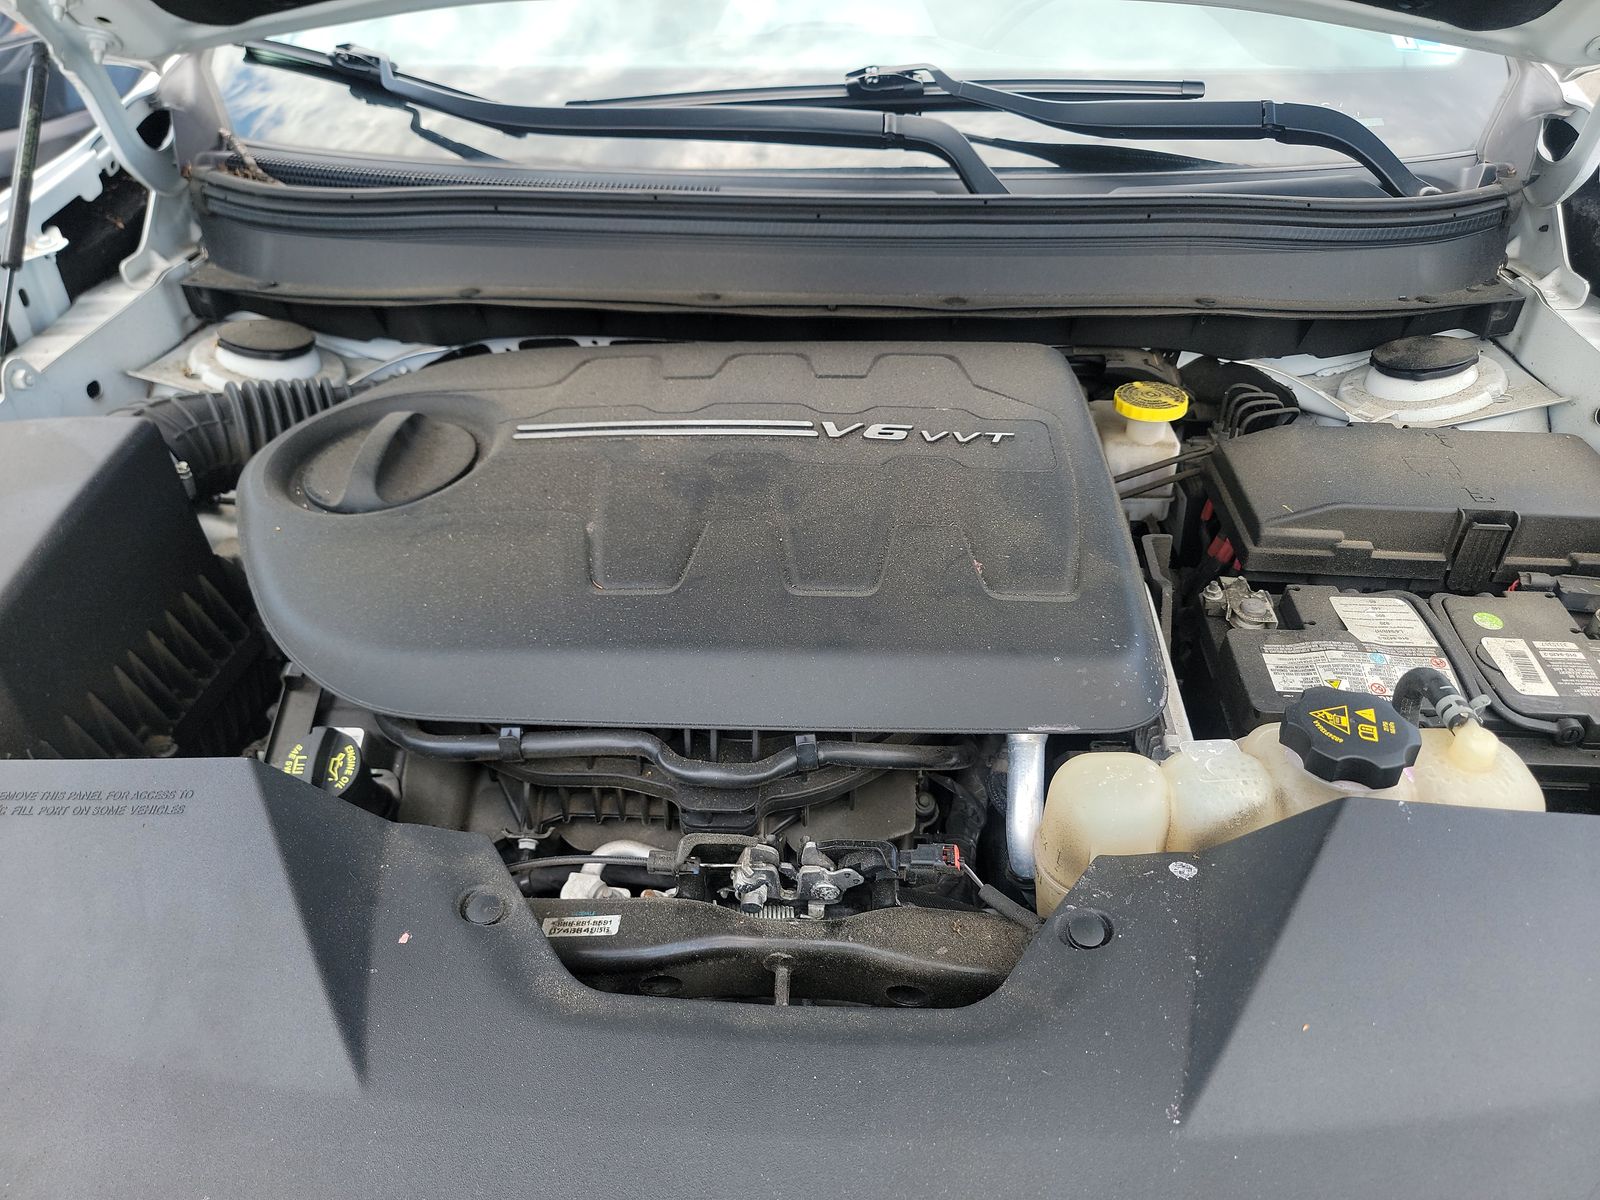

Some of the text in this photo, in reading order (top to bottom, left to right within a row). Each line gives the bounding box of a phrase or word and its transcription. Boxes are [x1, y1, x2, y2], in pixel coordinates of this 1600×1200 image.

[821, 421, 1015, 443] V6 VVT
[334, 745, 356, 789] ENGINE OIL
[40, 790, 66, 801] THIS
[67, 790, 103, 801] PANEL
[106, 790, 131, 801] FOR
[131, 789, 177, 801] ACCESS
[179, 788, 195, 800] TO
[11, 805, 34, 816] FILL
[37, 805, 71, 816] PORT
[72, 805, 91, 816] ON
[92, 805, 127, 816] SOME
[131, 804, 186, 816] VEHICLES
